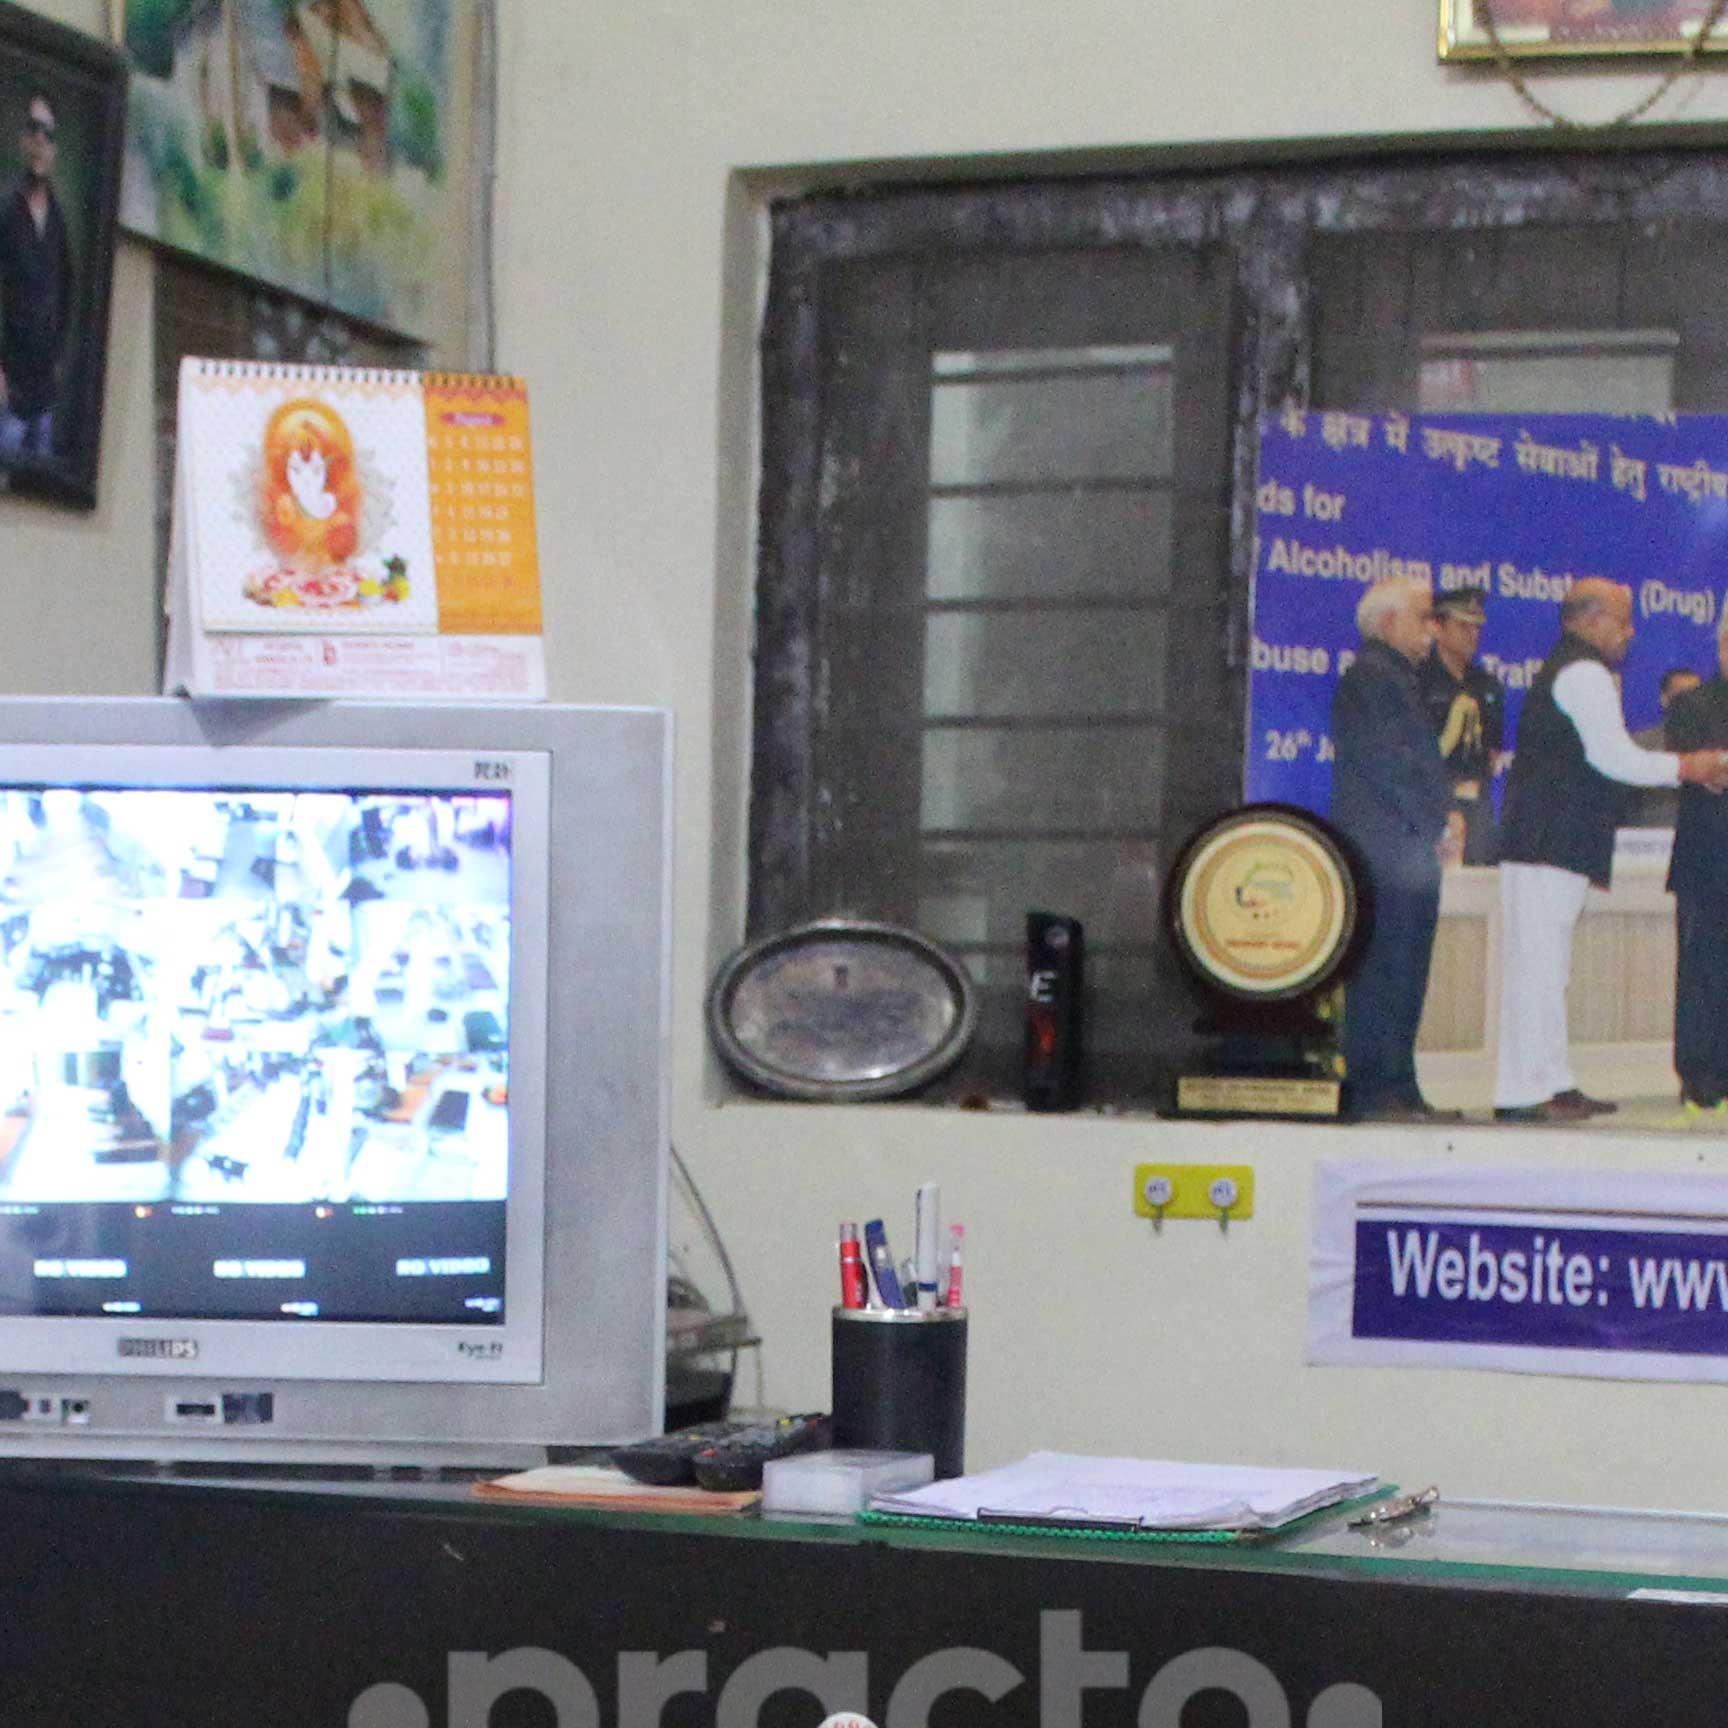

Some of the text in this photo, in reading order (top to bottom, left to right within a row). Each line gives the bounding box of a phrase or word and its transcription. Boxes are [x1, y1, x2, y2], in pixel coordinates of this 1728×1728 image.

[1303, 481, 1346, 521] for
[1439, 560, 1491, 593] and
[1640, 578, 1715, 624] (Drug)
[1386, 1229, 1609, 1307] Website:
